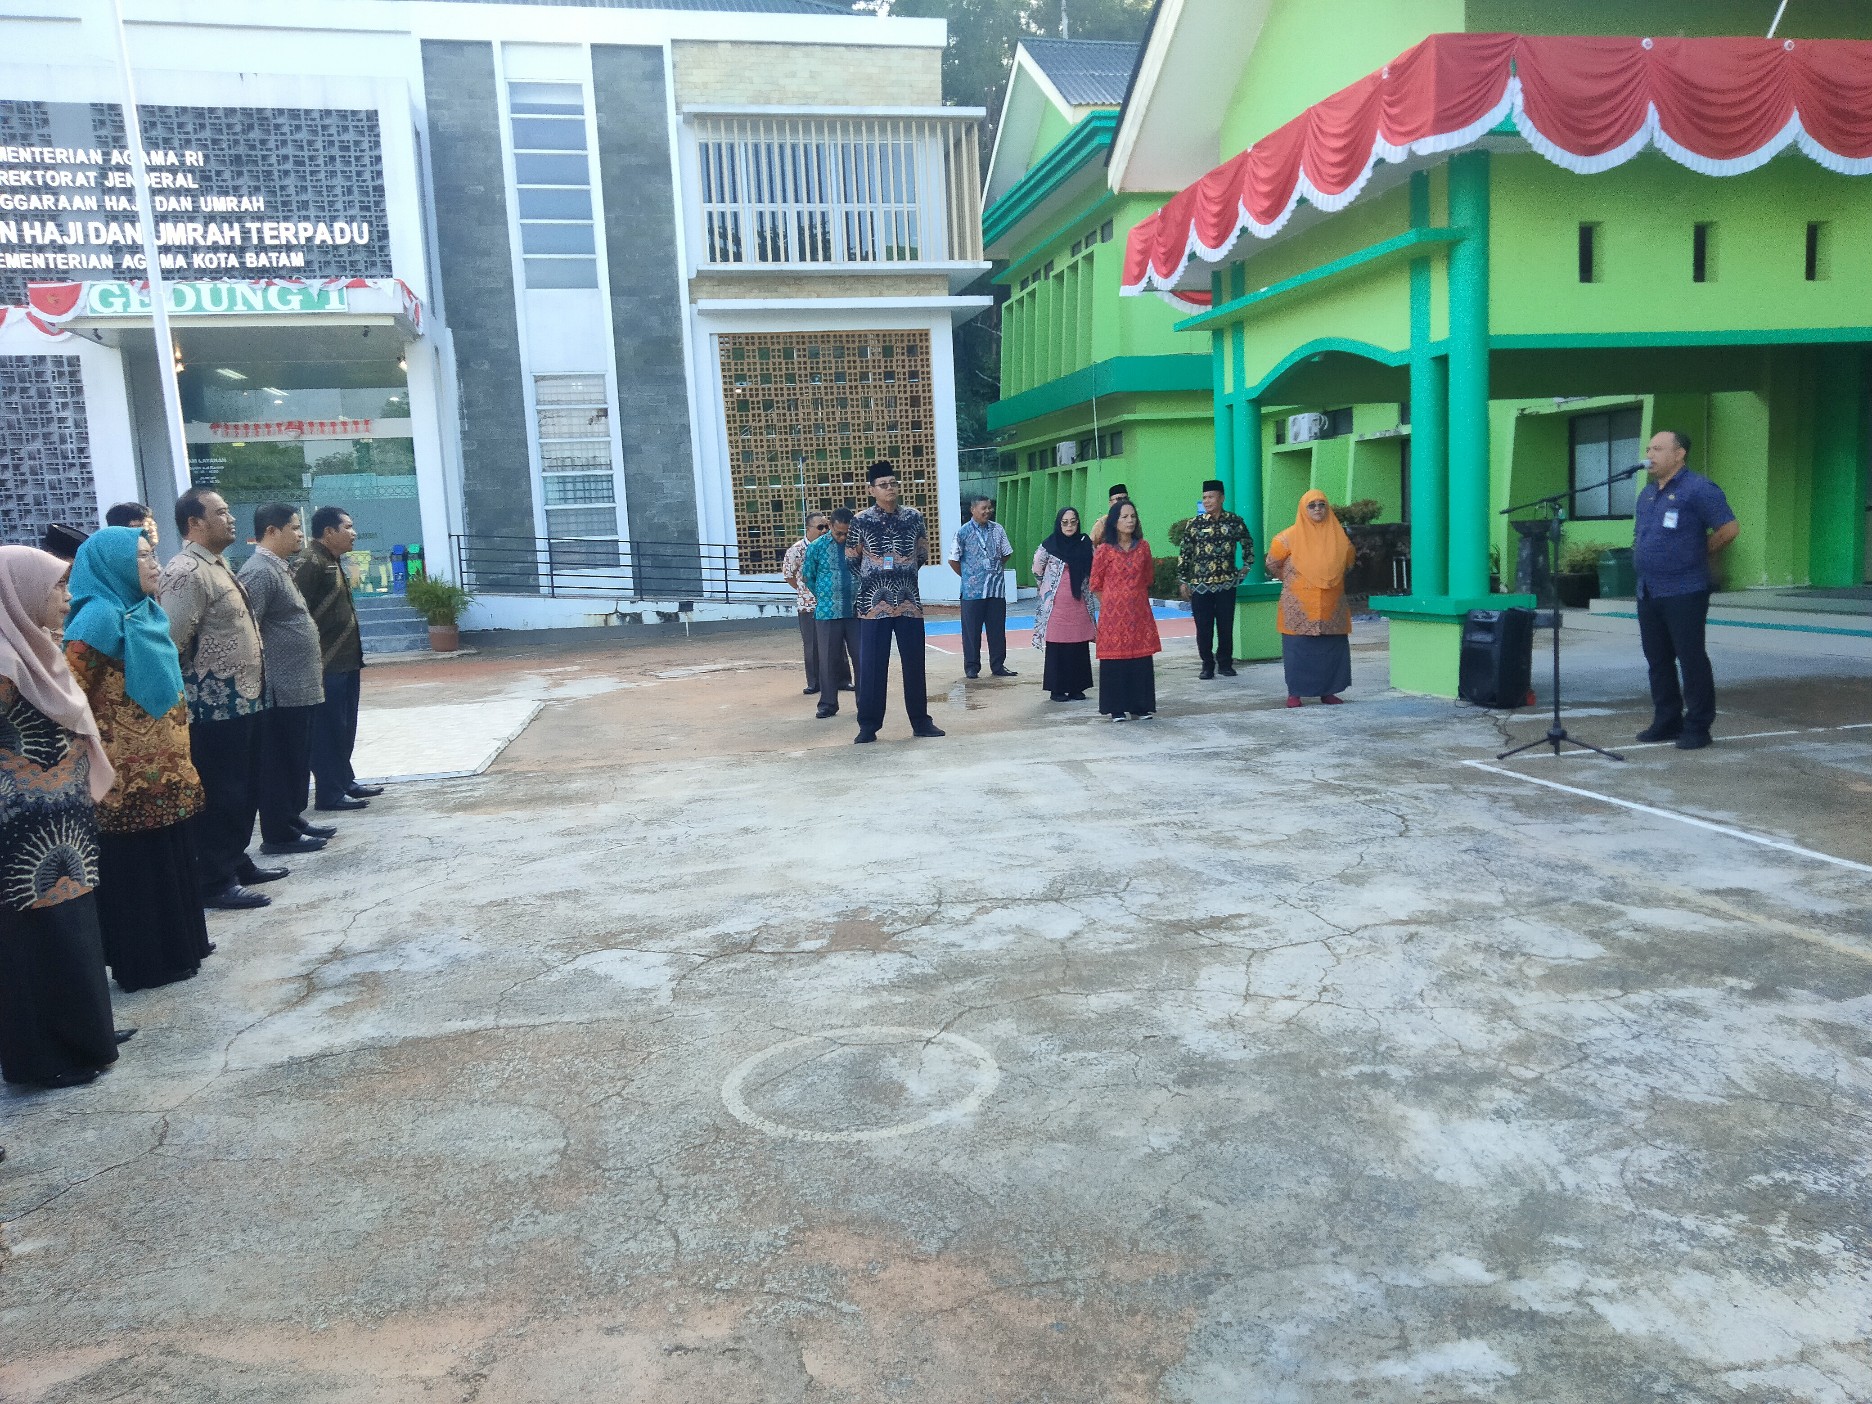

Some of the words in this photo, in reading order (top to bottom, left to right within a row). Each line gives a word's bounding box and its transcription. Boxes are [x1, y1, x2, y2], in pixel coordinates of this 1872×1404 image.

[111, 149, 179, 166] AGAMA
[184, 150, 204, 166] RI
[0, 170, 97, 187] REKTORAT
[0, 194, 98, 210] GGARAAN
[154, 196, 193, 211] DAN
[200, 196, 265, 211] UMRAH
[22, 221, 84, 244] HAJI
[87, 221, 143, 244] DAN
[155, 222, 241, 245] UMRAH
[245, 222, 369, 245] TERPADU
[122, 253, 188, 269] AGMA
[192, 253, 239, 269] KOTA
[246, 252, 304, 268] BATAM
[89, 283, 303, 313] GEDUNG
